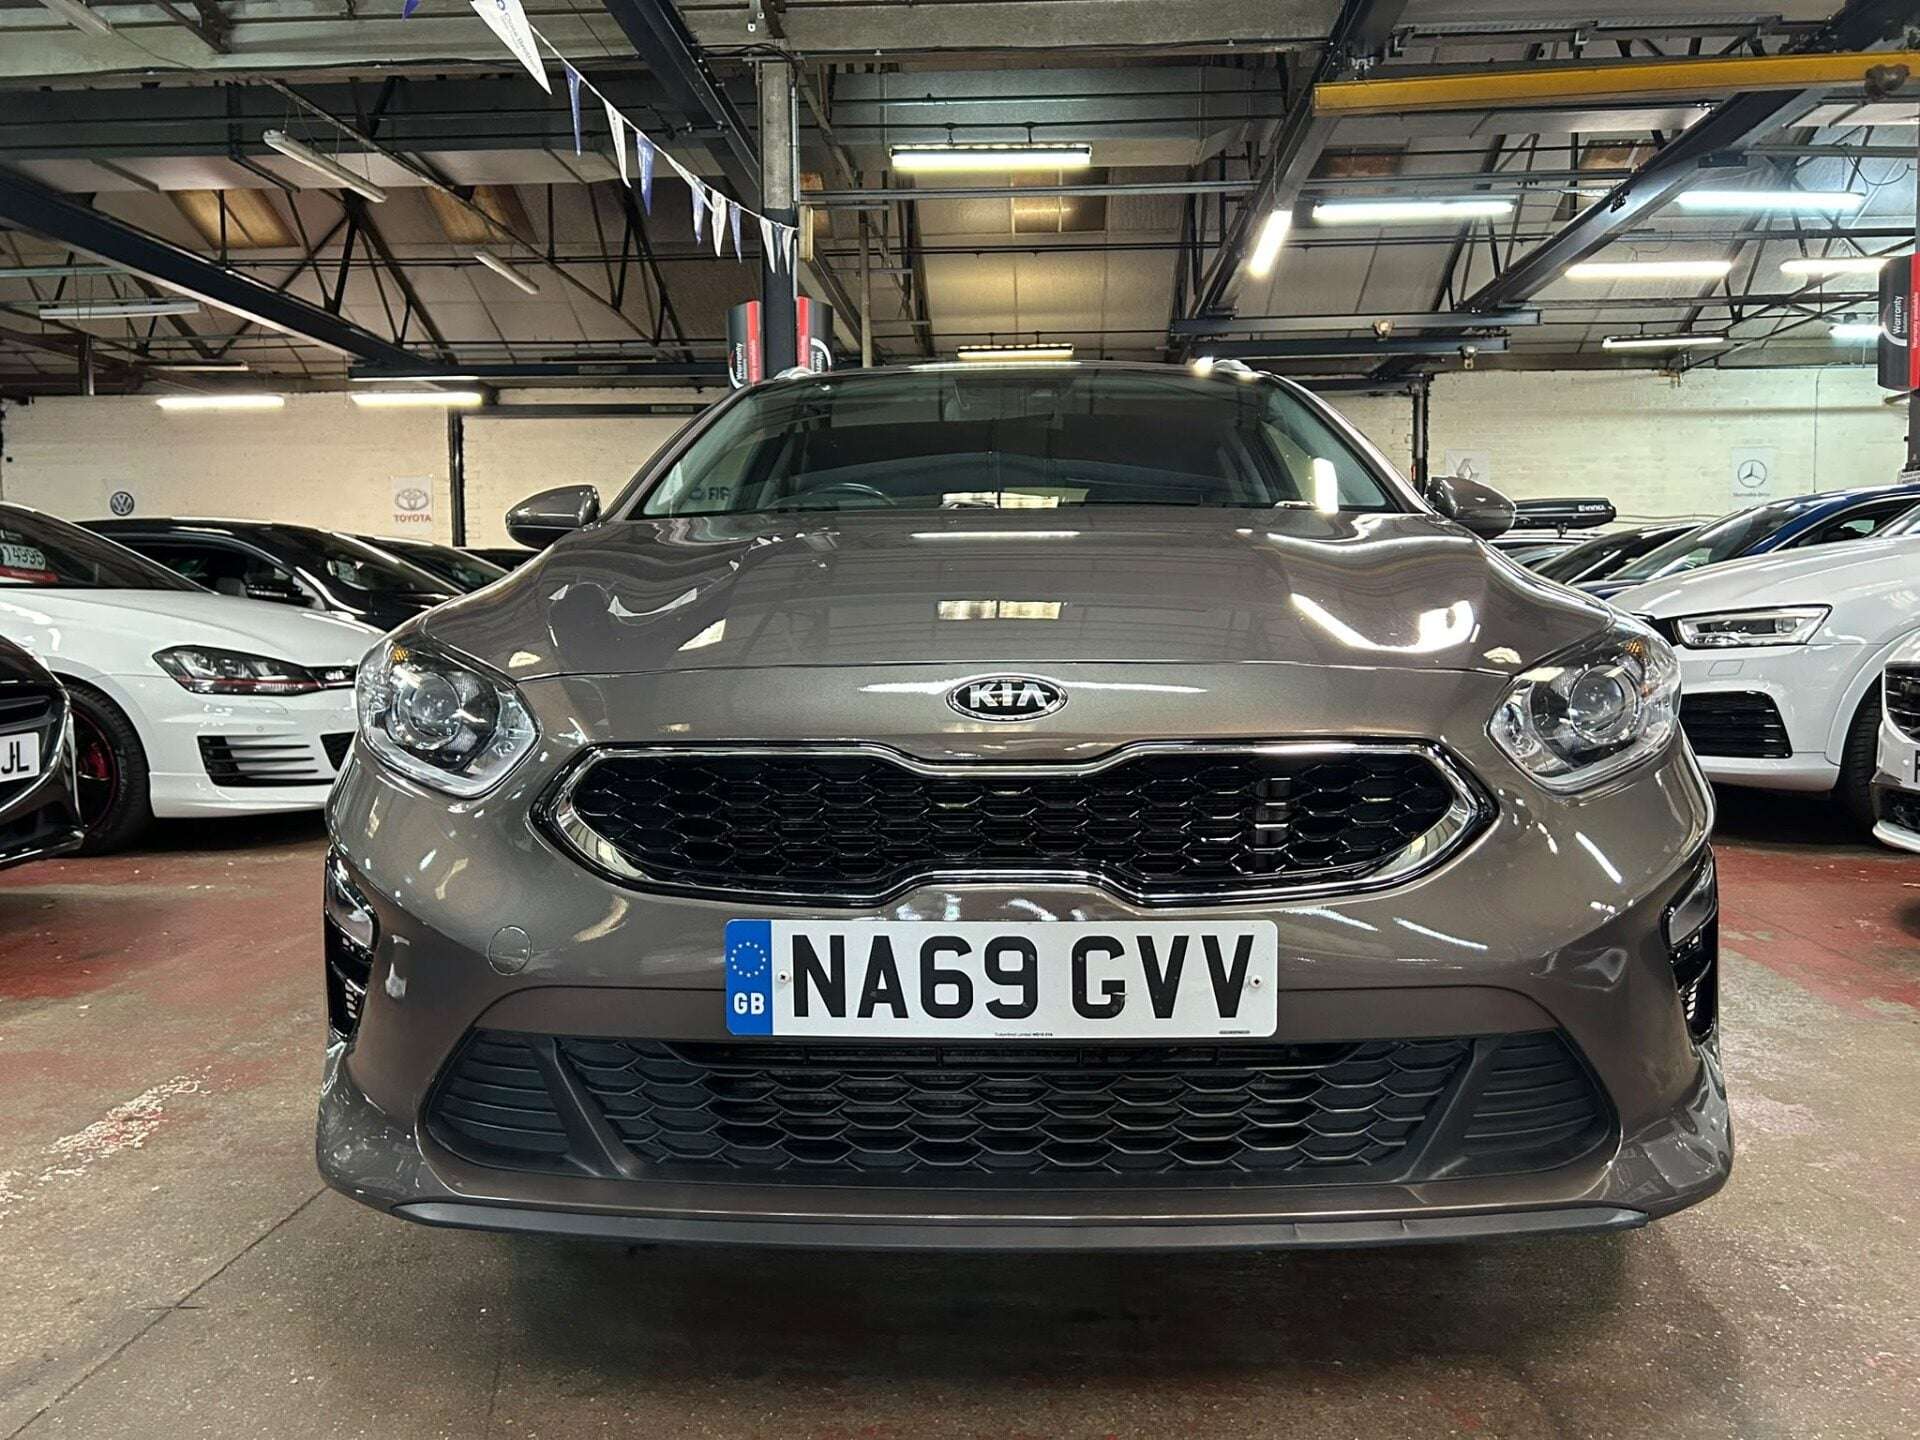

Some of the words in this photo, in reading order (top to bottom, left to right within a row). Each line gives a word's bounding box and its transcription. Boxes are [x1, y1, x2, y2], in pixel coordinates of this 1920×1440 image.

[1892, 295, 1904, 335] Warranty
[393, 513, 432, 522] TOYOTA
[969, 683, 1047, 708] KIA
[792, 935, 1038, 1019] NA69
[1071, 935, 1254, 1019] GVV
[734, 992, 764, 1015] GB
